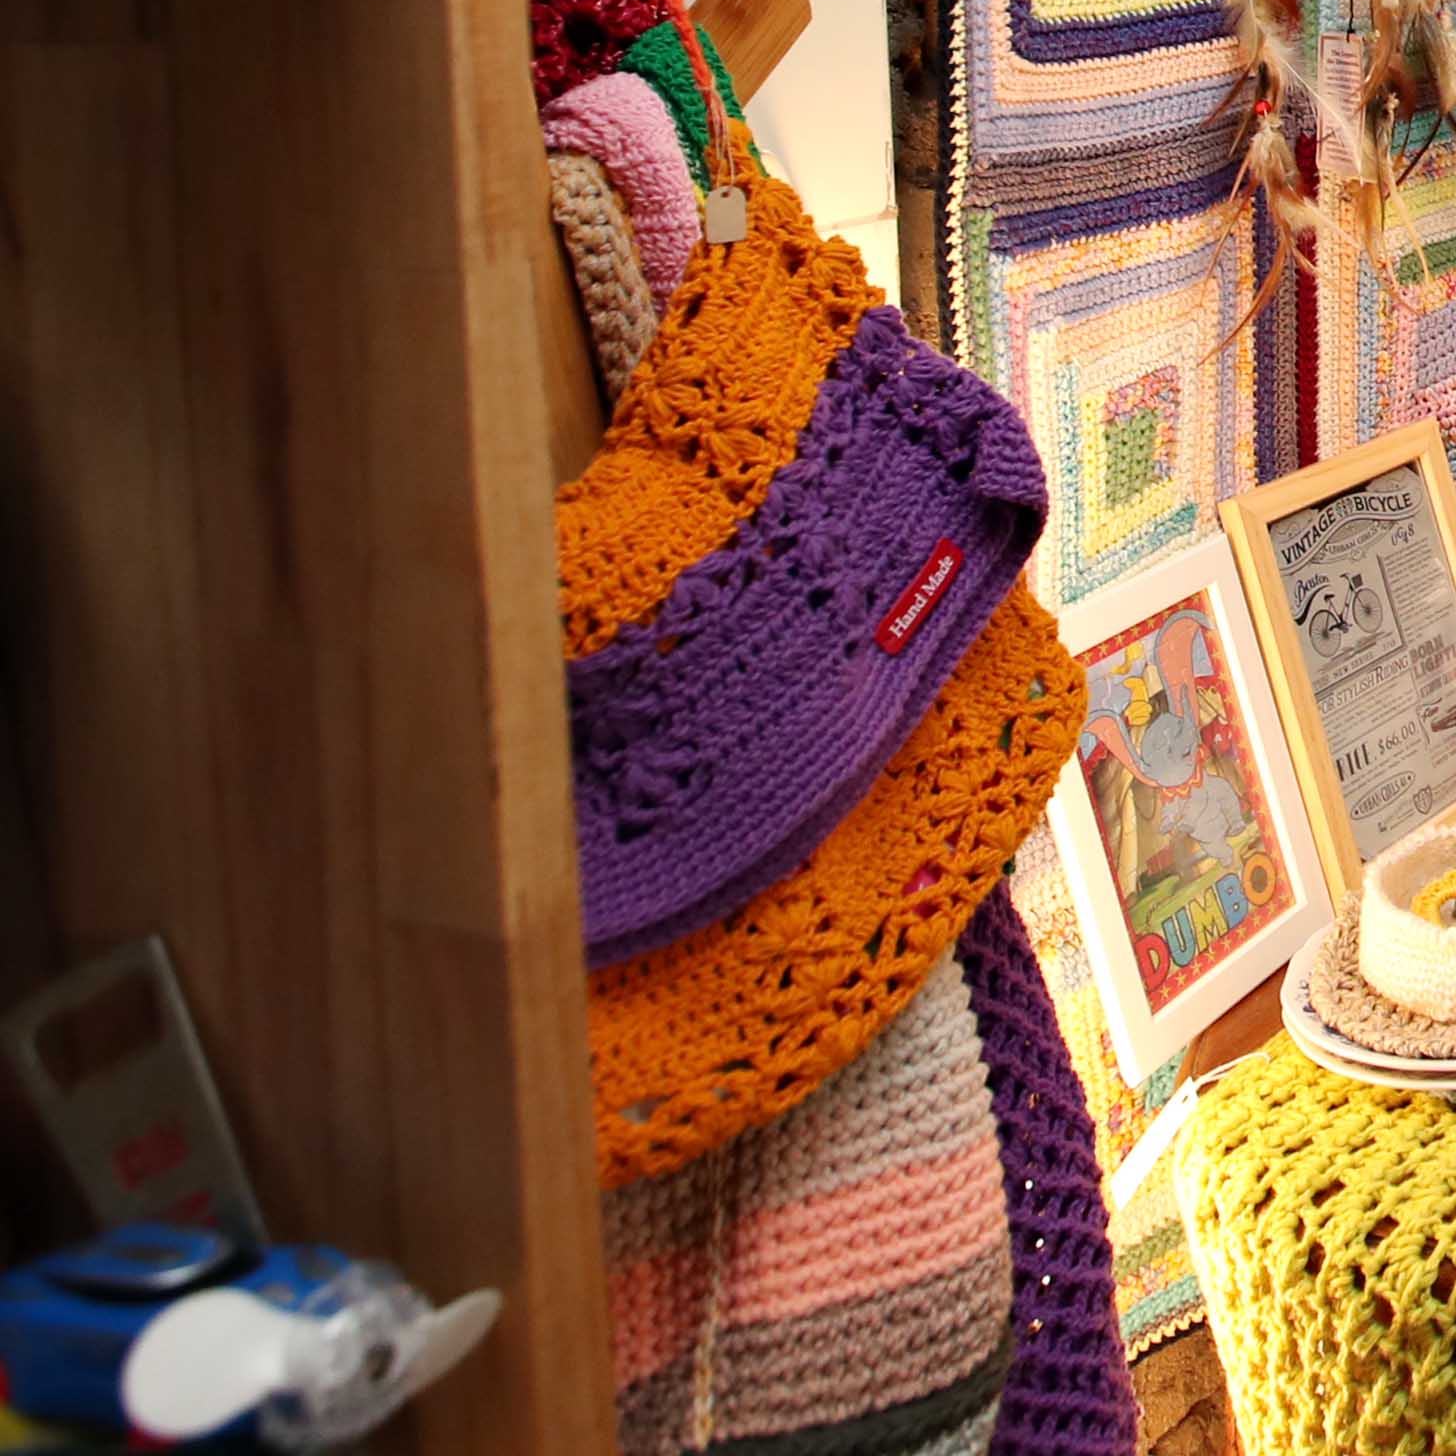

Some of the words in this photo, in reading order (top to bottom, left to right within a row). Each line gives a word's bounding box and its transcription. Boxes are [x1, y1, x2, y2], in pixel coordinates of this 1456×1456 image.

[1281, 508, 1337, 564] VINTAGE
[1353, 493, 1413, 512] BICYCLE
[888, 593, 928, 638] Hand
[921, 555, 954, 596] Made
[1410, 634, 1444, 661] BORN
[1336, 672, 1377, 706] STYLISH
[1135, 851, 1277, 992] DUMBO
